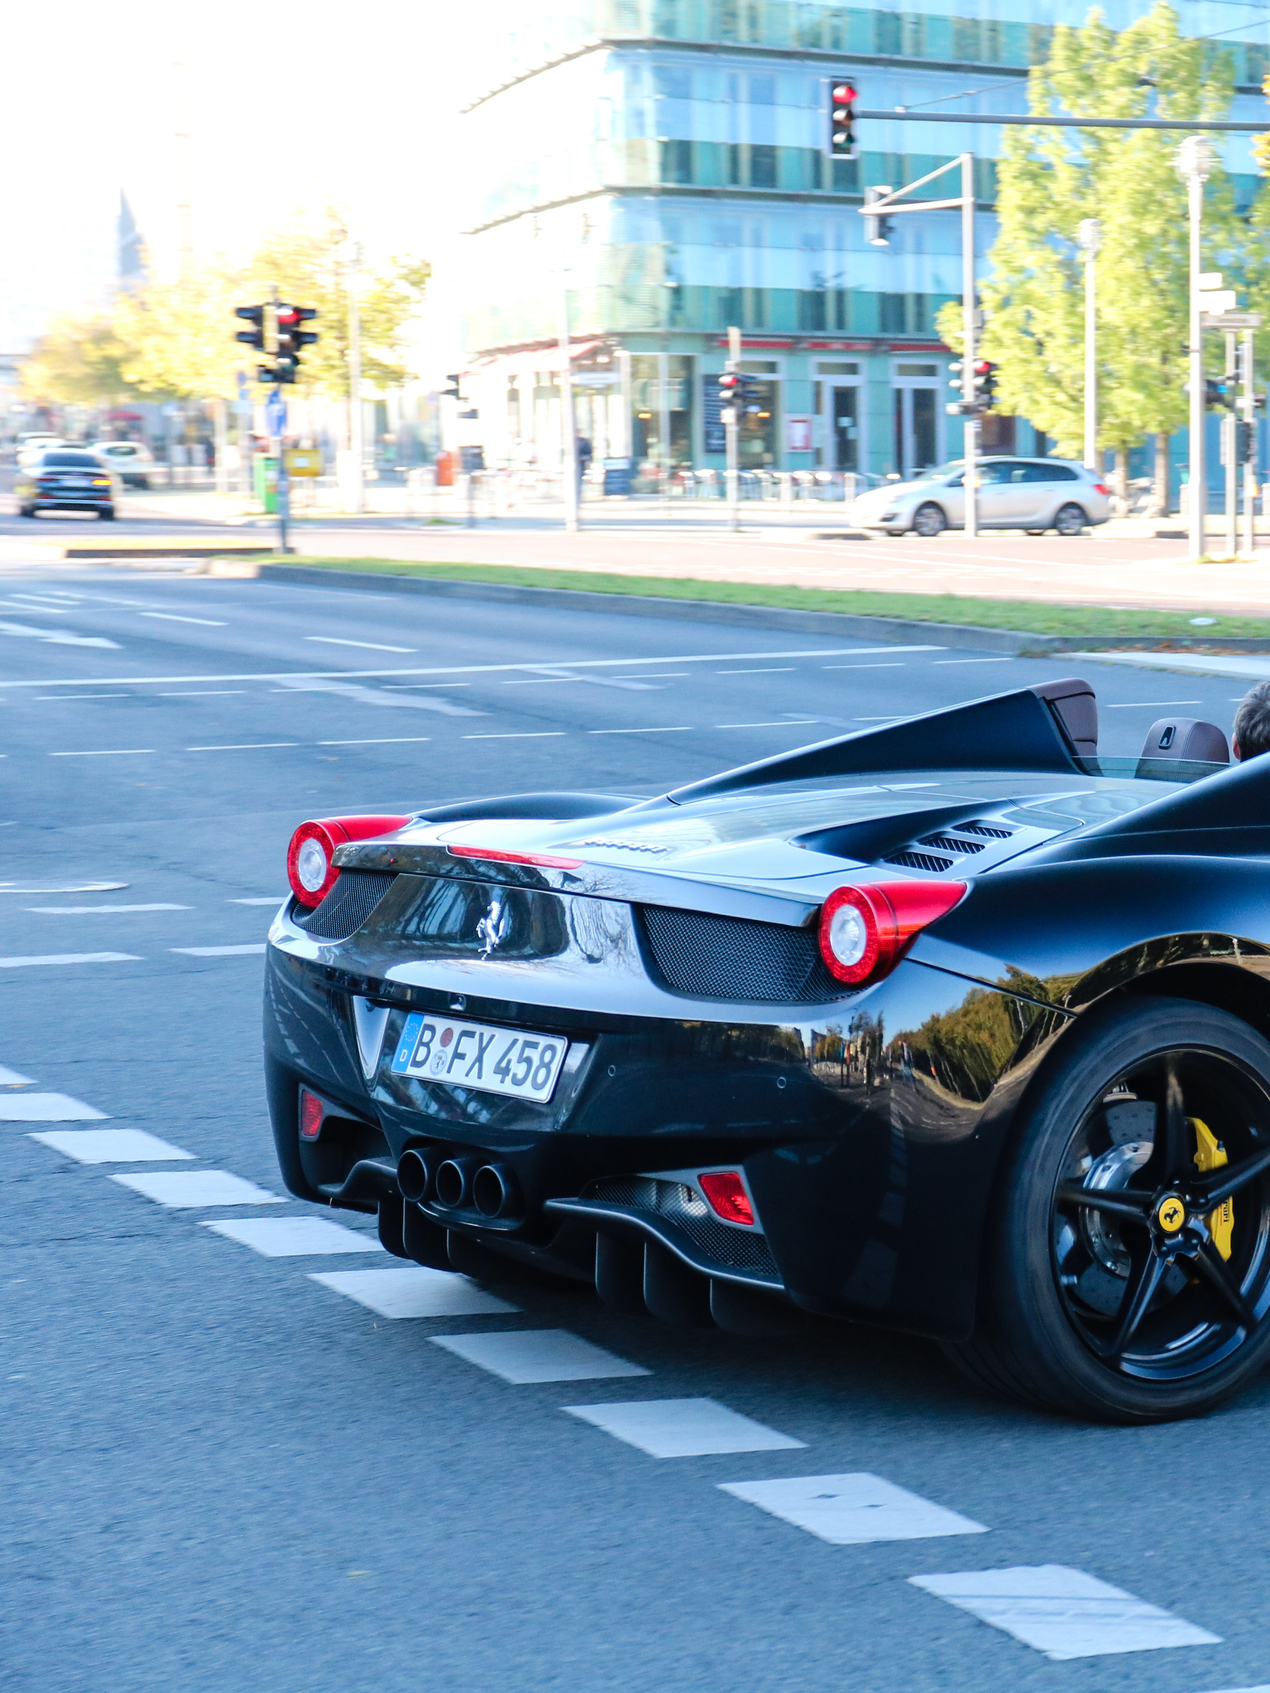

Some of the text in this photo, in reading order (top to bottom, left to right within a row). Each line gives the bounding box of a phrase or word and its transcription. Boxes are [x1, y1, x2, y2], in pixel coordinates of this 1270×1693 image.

[399, 1049, 407, 1062] D
[410, 1023, 557, 1091] B FX 458
